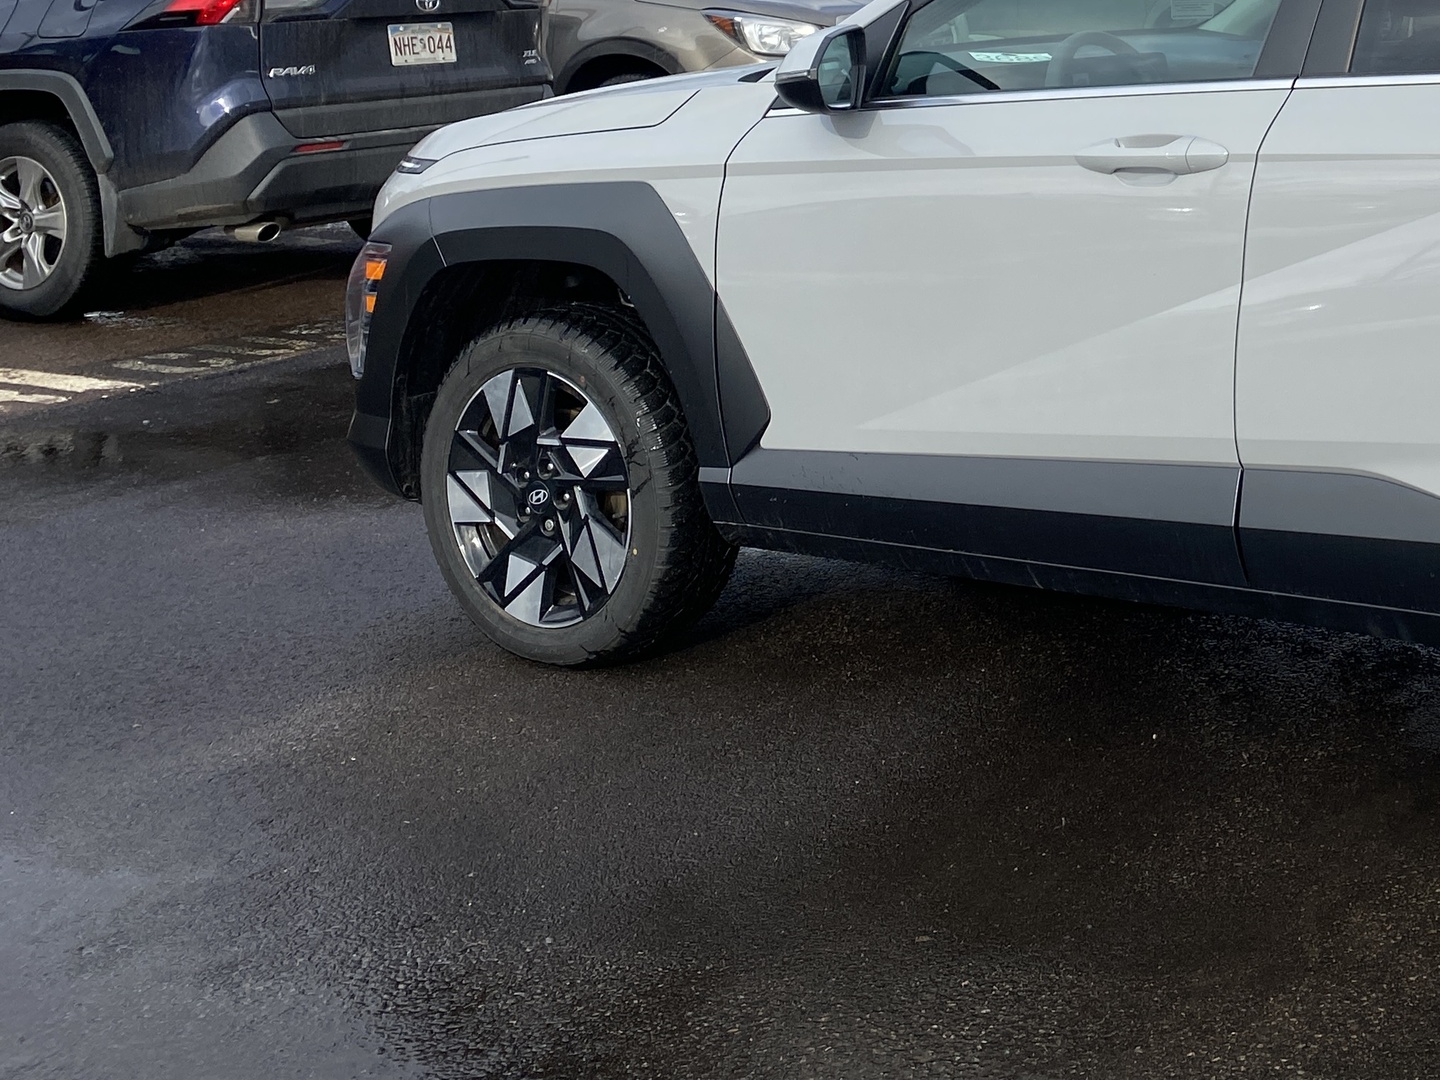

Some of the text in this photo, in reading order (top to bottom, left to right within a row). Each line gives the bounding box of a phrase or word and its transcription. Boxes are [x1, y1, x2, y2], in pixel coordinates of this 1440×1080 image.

[393, 34, 453, 57] NHE 044
[267, 63, 316, 78] RAV4
